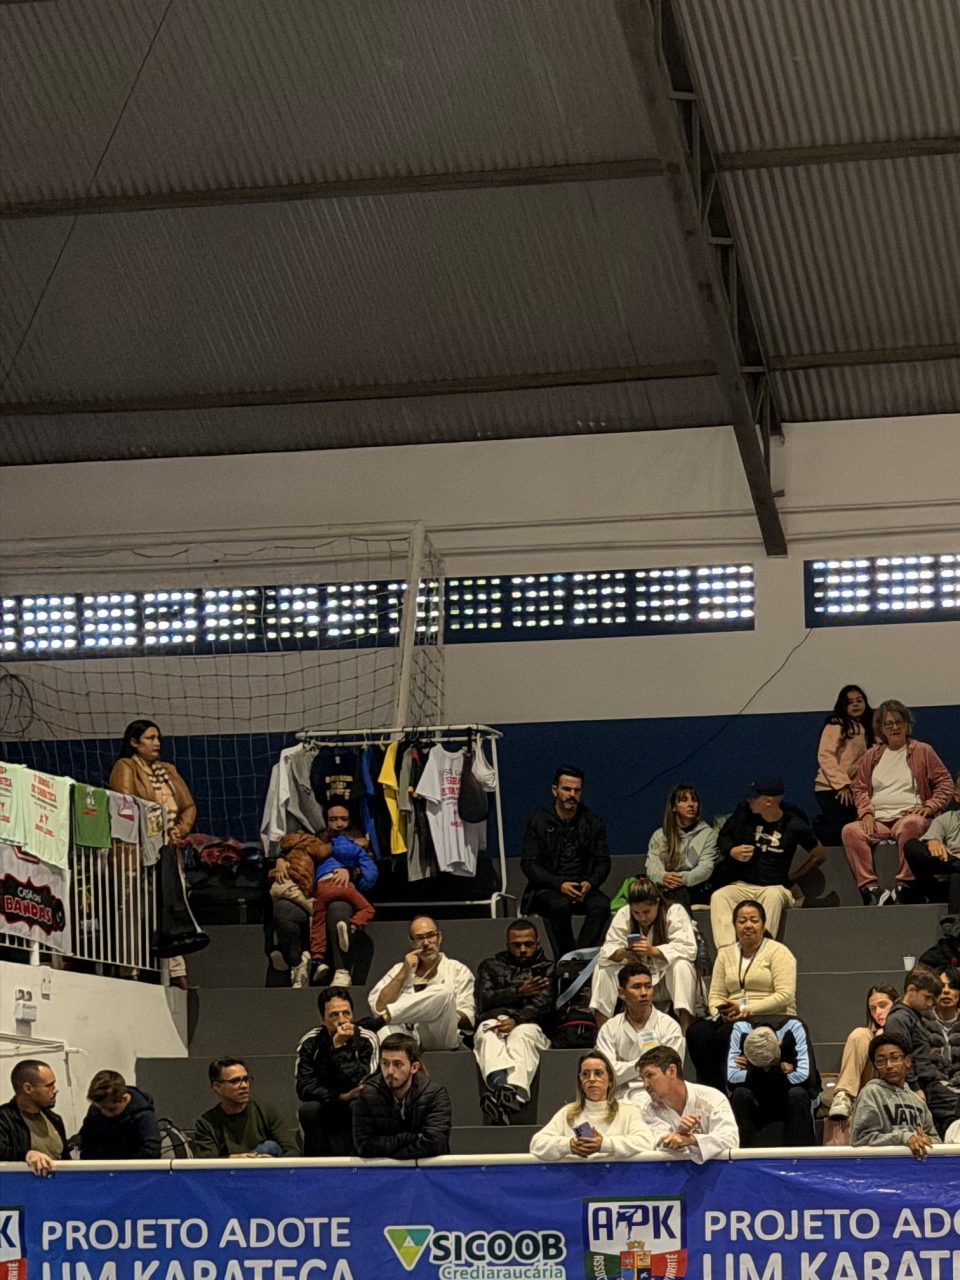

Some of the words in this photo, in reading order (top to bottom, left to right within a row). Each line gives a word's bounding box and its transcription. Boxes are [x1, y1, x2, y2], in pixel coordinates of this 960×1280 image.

[41, 1219, 209, 1251] PROJETO
[219, 1217, 351, 1249] ADOTE
[704, 1207, 880, 1241] PROJETO
[431, 1232, 565, 1262] SICOOB
[441, 1264, 564, 1280] Crediaraucária
